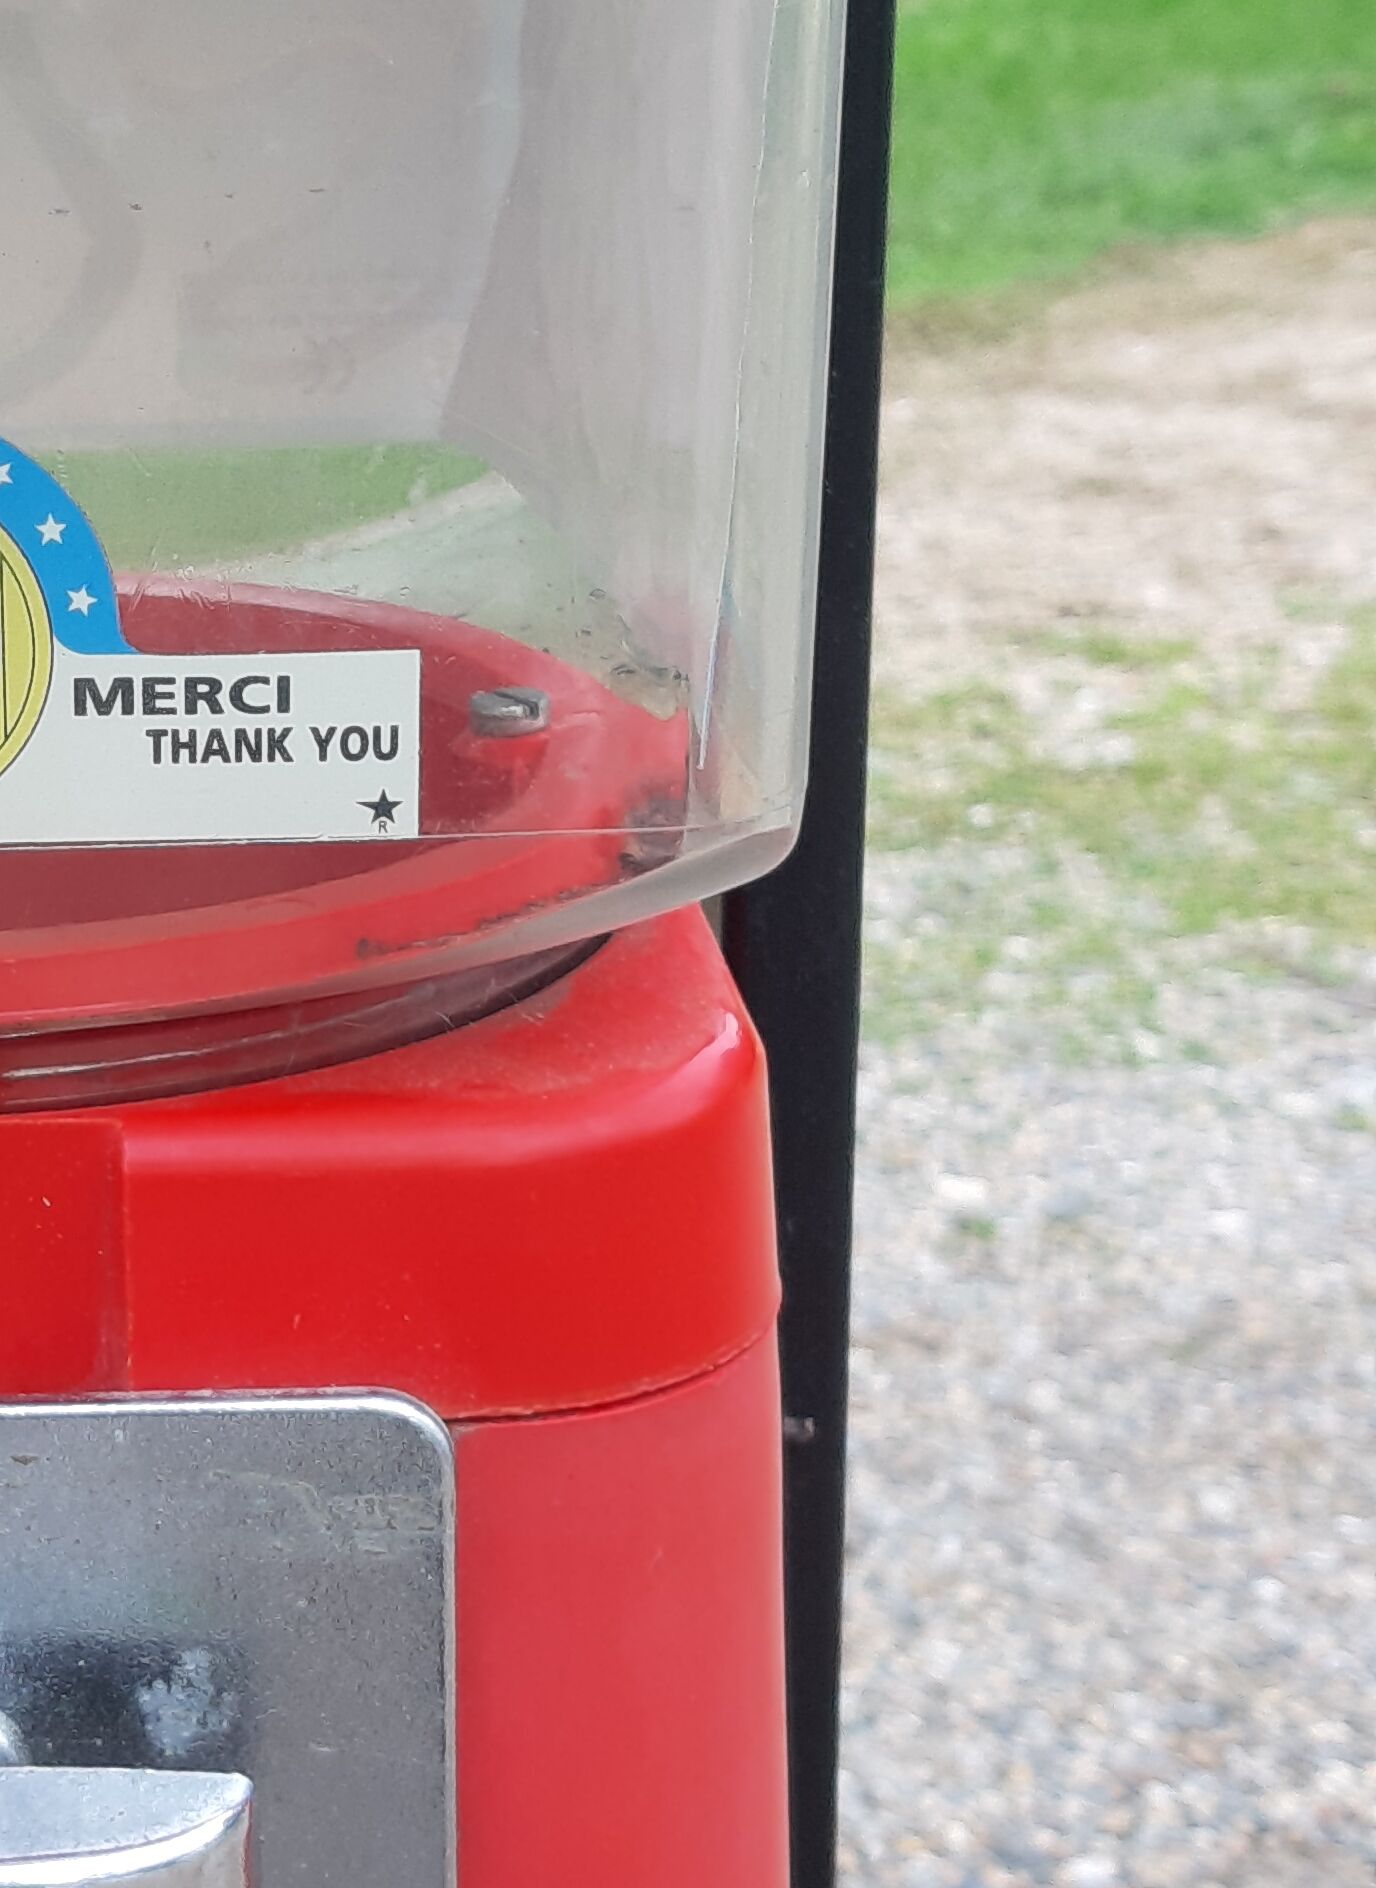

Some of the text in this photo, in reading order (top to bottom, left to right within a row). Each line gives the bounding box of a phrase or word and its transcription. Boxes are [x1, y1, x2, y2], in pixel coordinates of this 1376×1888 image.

[74, 675, 291, 716] MERCI
[145, 724, 399, 764] THANK YOU
